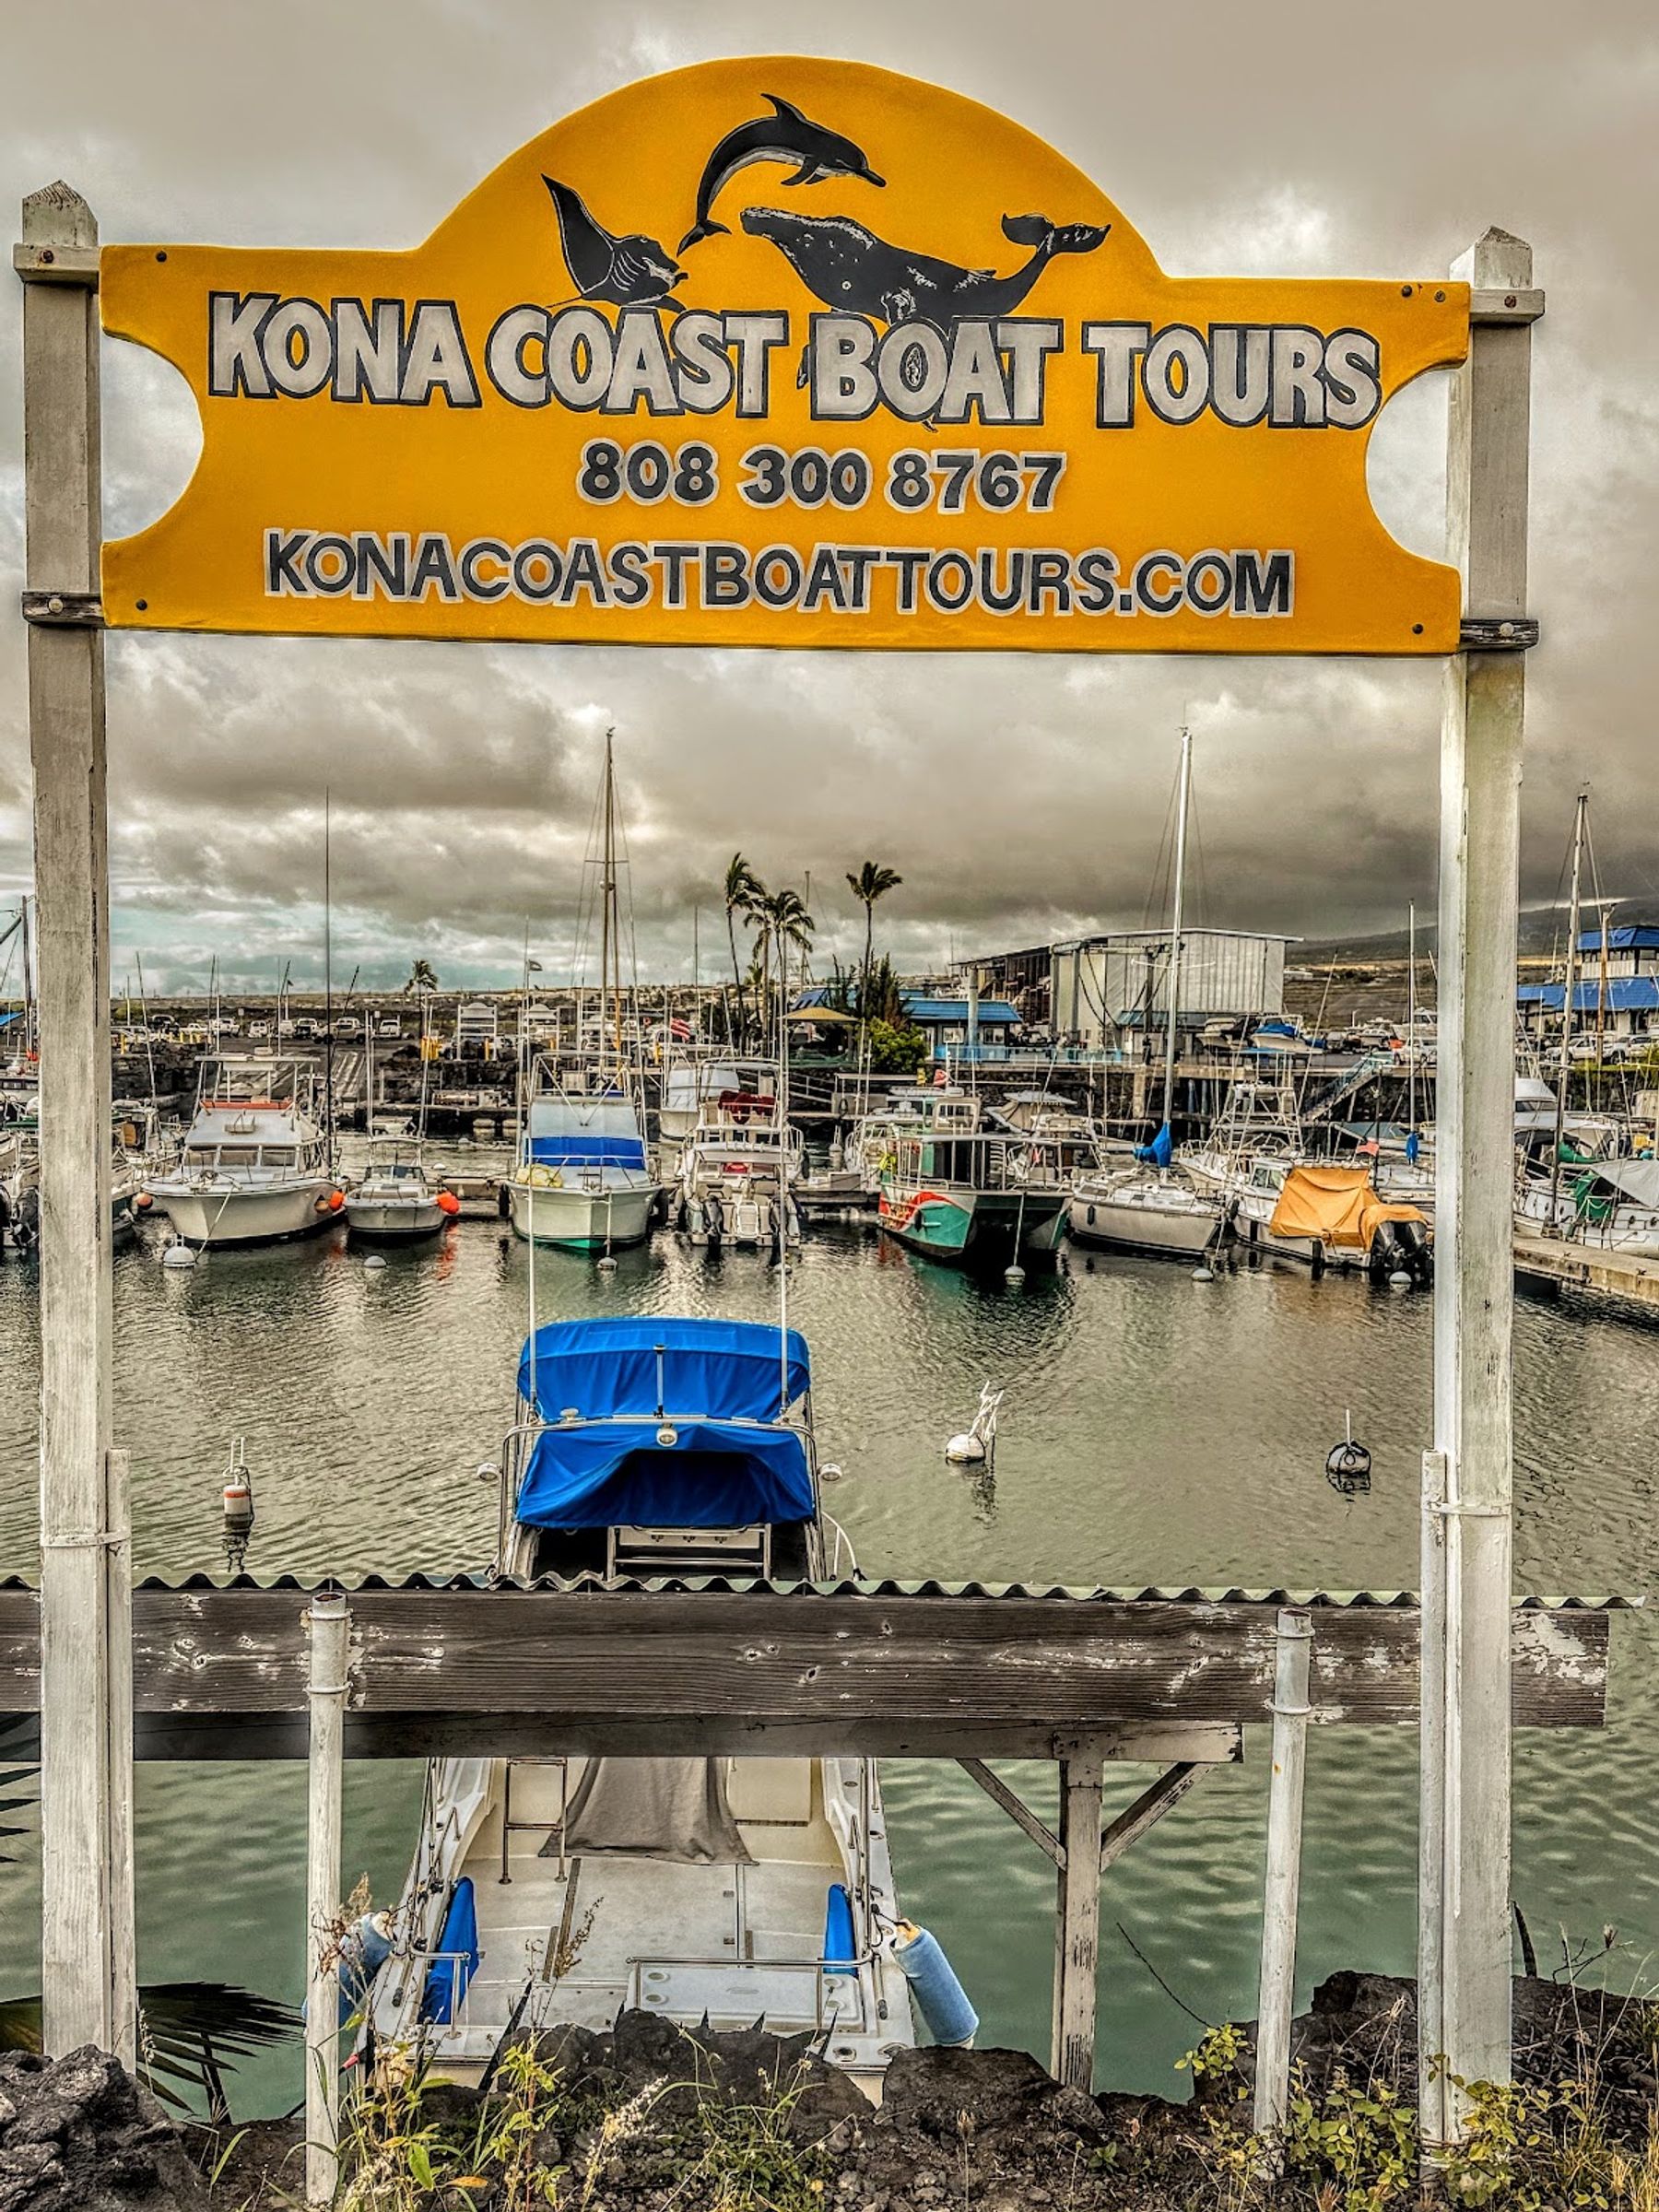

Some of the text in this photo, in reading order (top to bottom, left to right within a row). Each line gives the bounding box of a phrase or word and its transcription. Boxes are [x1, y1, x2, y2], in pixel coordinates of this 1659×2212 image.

[208, 290, 1382, 430] KONA COAST BOAT TOURS
[576, 438, 1067, 514] 808 300 8767
[264, 527, 1295, 619] KONACOASTBOATTOURS.COM
